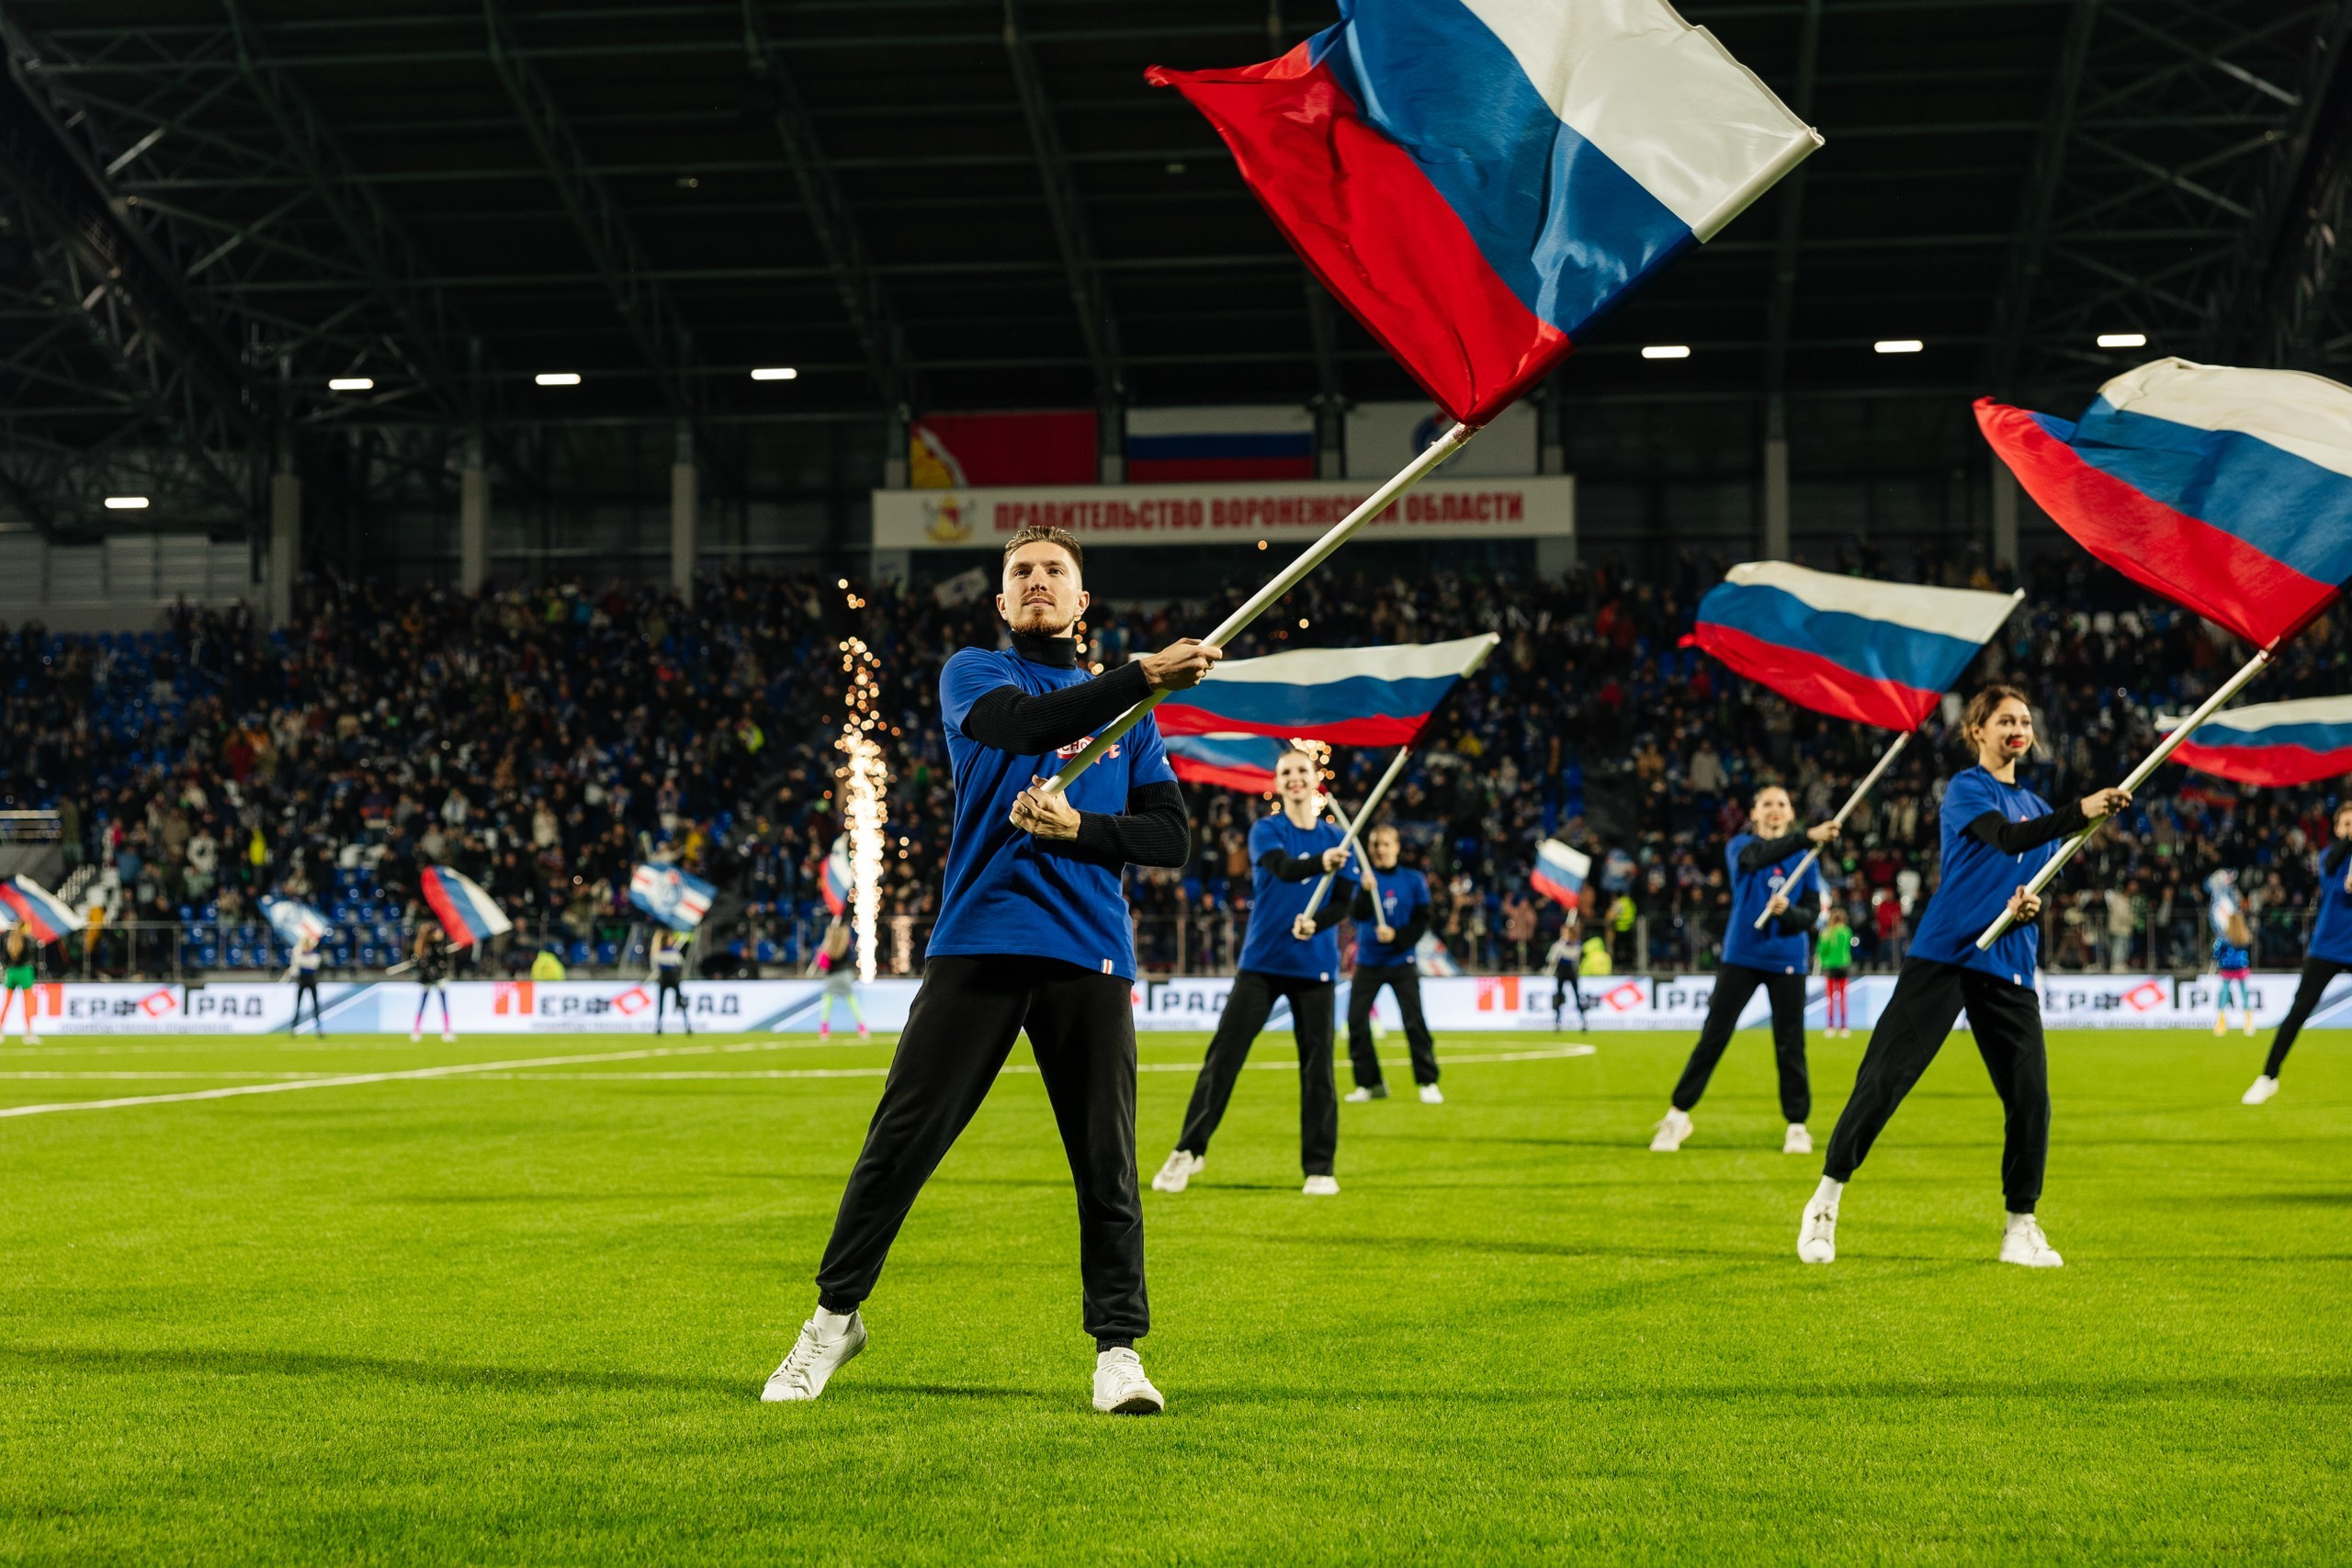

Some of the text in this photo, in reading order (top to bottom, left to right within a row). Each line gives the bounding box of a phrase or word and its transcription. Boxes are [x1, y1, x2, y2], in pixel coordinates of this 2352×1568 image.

[994, 498, 1204, 531] ПРАВИТЕЛЬСТВО
[1406, 492, 1525, 524] ОБЛАСТИ
[494, 980, 739, 1015] ПЕРФОРАД
